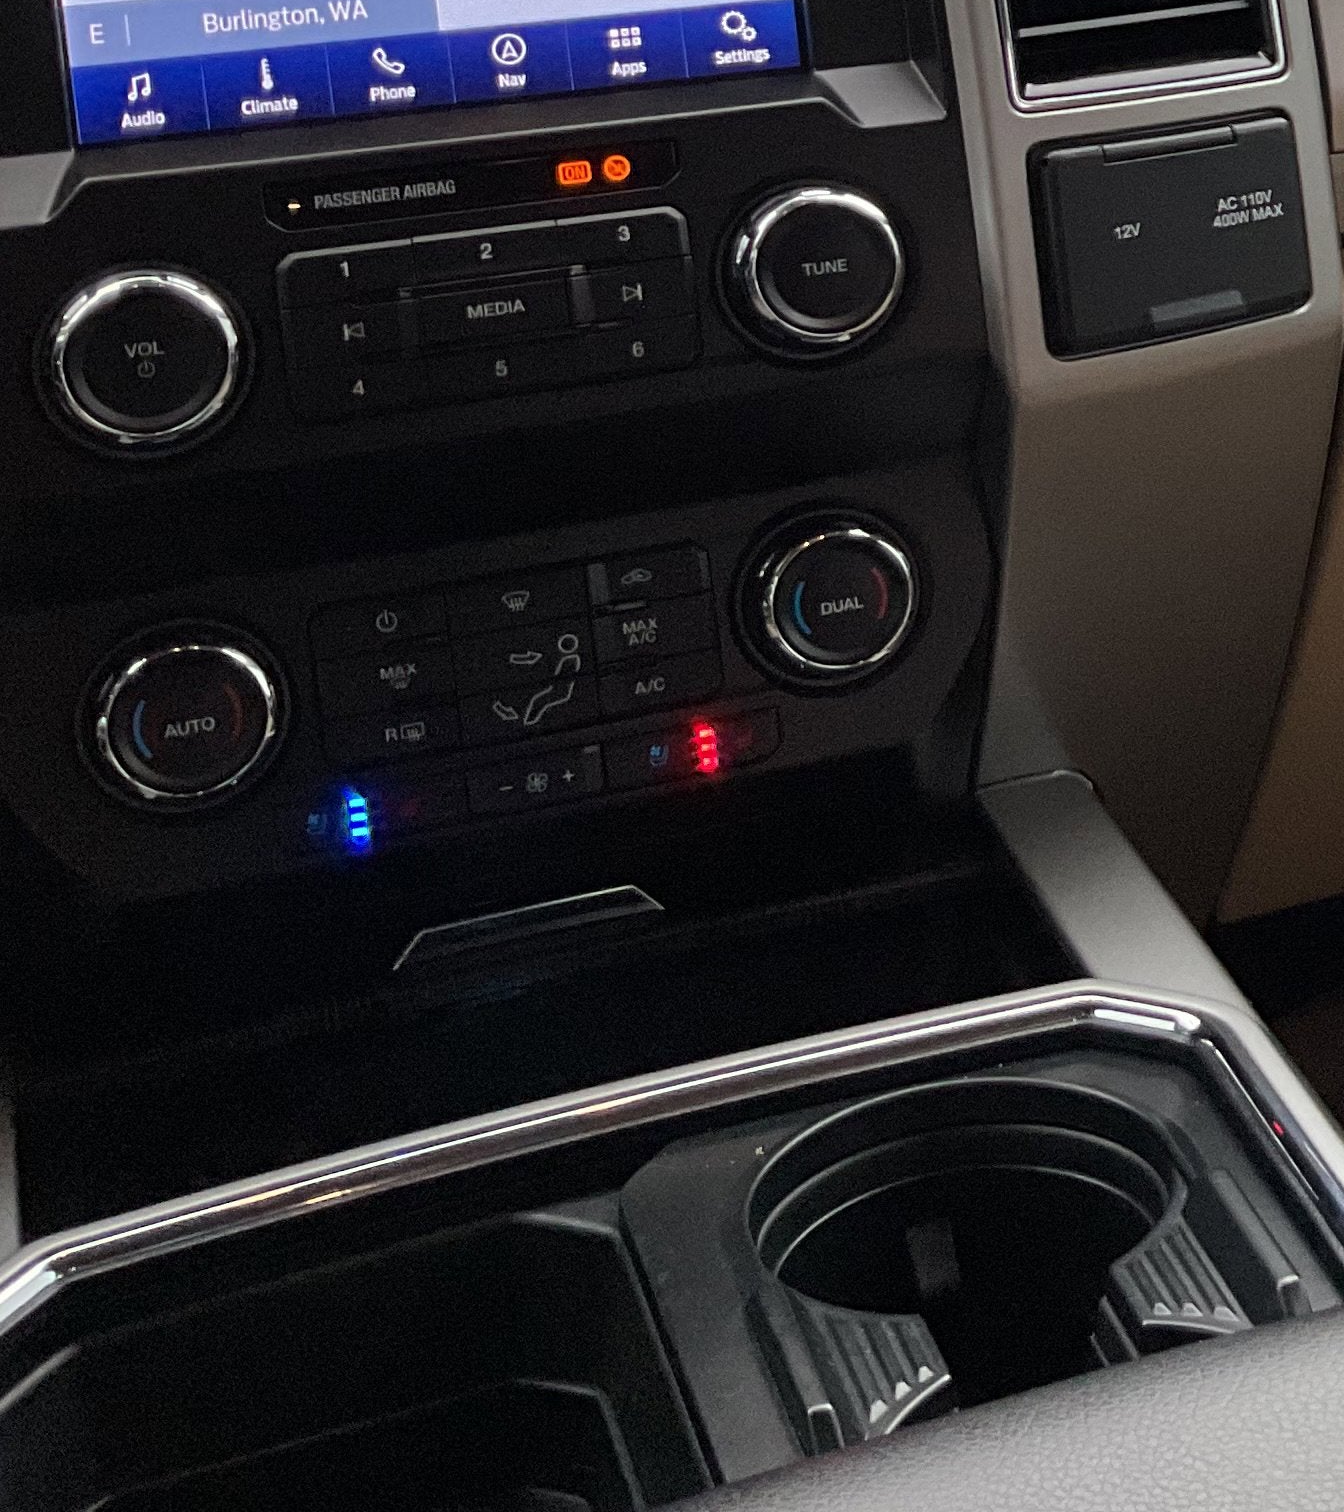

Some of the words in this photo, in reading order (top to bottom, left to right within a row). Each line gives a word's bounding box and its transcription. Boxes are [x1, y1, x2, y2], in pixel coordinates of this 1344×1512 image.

[89, 23, 105, 45] E
[203, 7, 325, 35] Burlington,
[715, 47, 770, 66] Settings
[611, 61, 647, 78] Apps
[498, 72, 527, 88] Nav
[369, 84, 416, 102] Phone
[240, 97, 299, 115] Climate
[121, 110, 166, 130] Audio
[564, 164, 587, 179] ON
[314, 186, 400, 209] PASSENGER
[403, 179, 457, 201] AIRBAG
[1217, 196, 1238, 212] AC
[1241, 189, 1272, 207] 110V
[1213, 210, 1250, 227] 400W
[1251, 202, 1284, 221] MAX
[617, 225, 631, 242] 3
[1114, 222, 1141, 239] 12V
[480, 243, 493, 260] 2
[339, 261, 350, 278] 1
[802, 258, 848, 277] TUNE
[467, 299, 526, 320] MEDIA
[124, 341, 165, 359] VOL
[632, 342, 644, 358] 6
[495, 360, 507, 376] 5
[352, 380, 365, 396] 4
[820, 596, 864, 616] DUAL
[623, 618, 658, 635] MAX
[628, 630, 657, 646] A/C
[379, 662, 418, 682] MAX
[635, 677, 665, 694] A/C
[164, 716, 216, 739] AUTO
[385, 727, 398, 743] R
